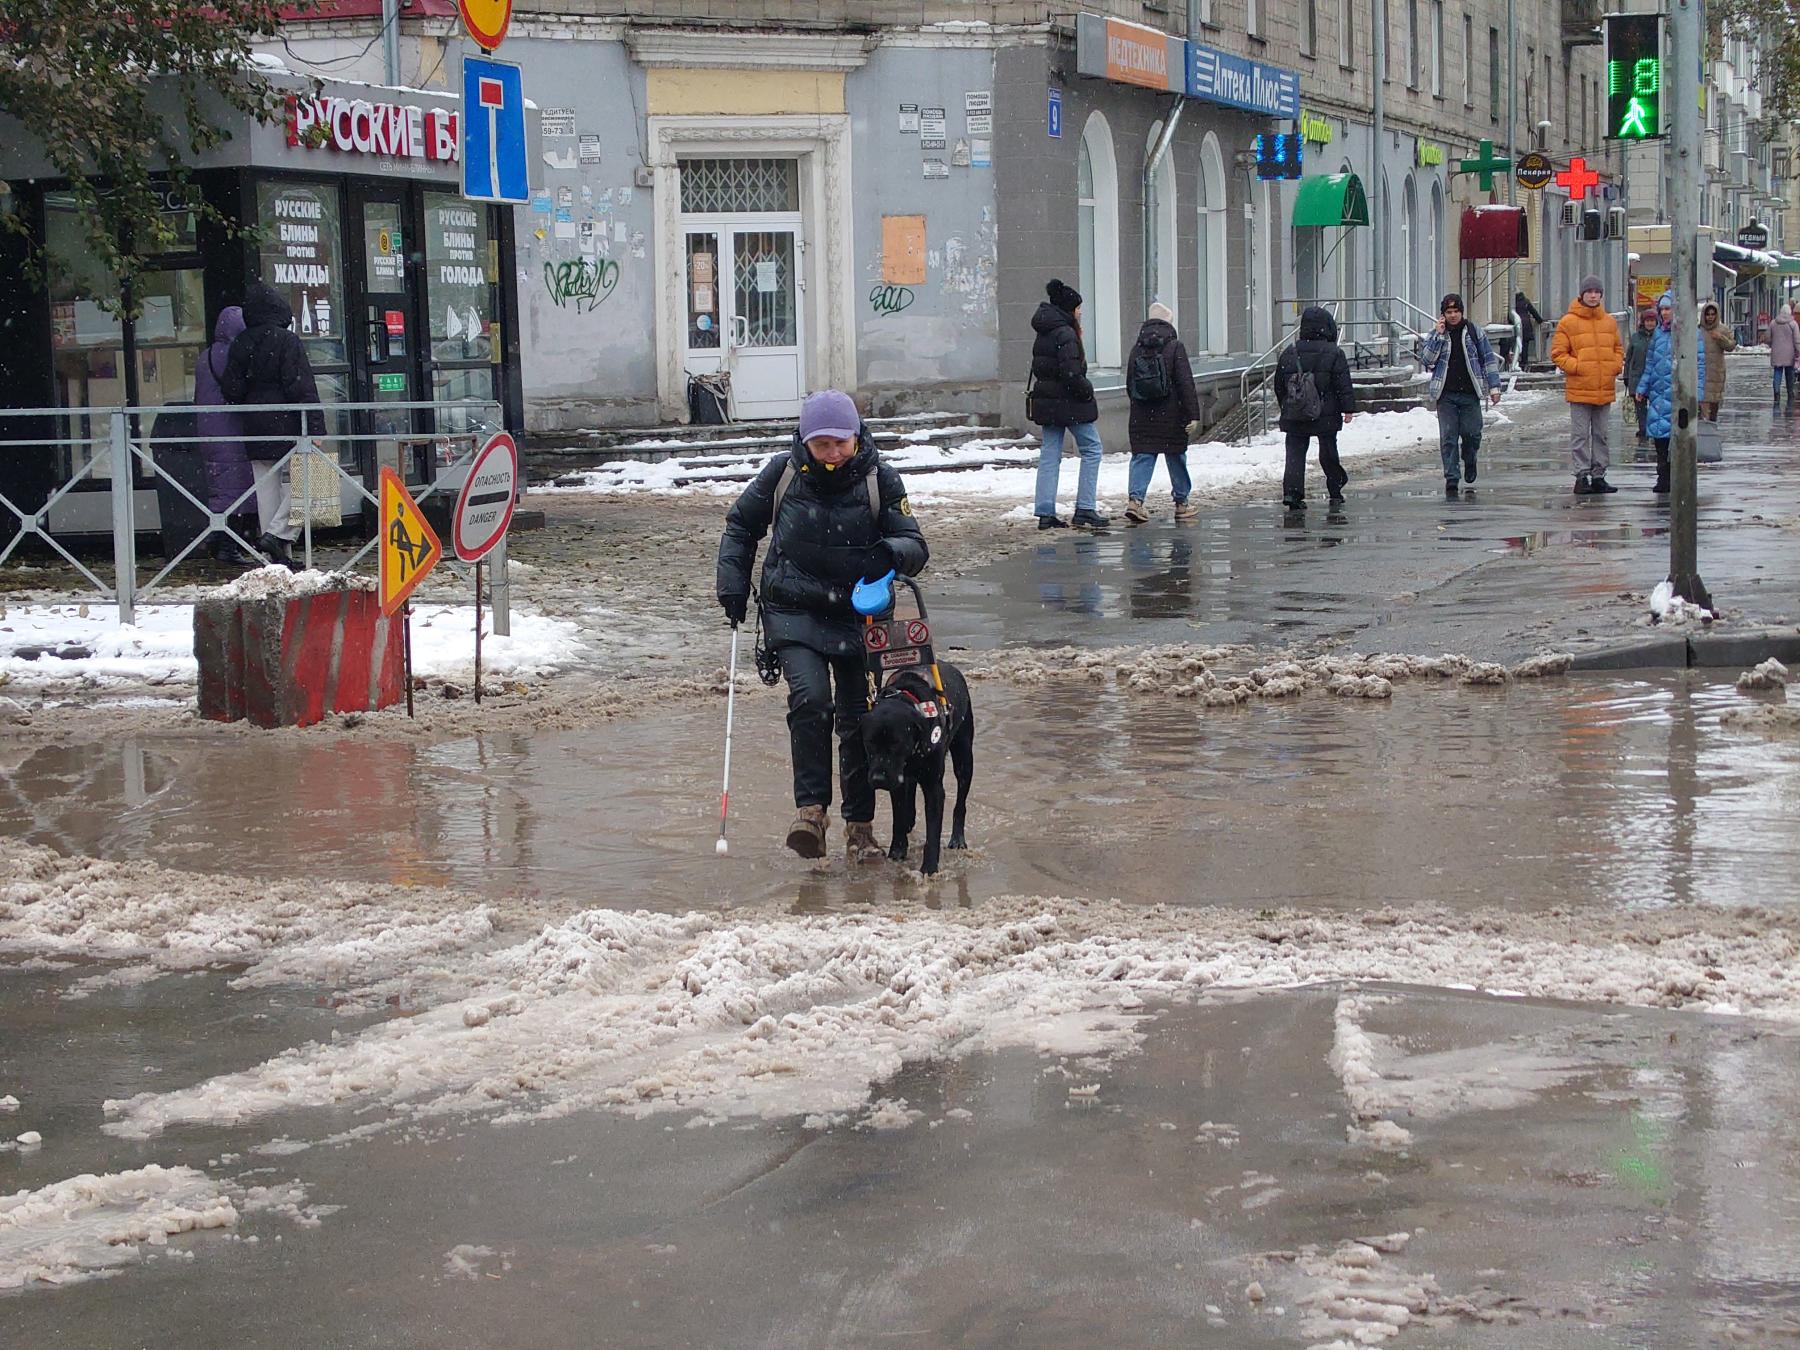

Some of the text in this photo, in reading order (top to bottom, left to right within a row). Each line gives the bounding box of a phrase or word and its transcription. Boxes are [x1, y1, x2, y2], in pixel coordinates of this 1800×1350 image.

[1108, 36, 1167, 76] МЕДТЕХНИКА
[1608, 59, 1659, 96] 18
[1053, 105, 1058, 131] 9
[275, 199, 321, 219] РУССКИЕ
[438, 209, 477, 227] РУССКИЕ
[280, 224, 318, 243] БЛИНЫ
[443, 231, 475, 248] БЛИНЫ
[286, 245, 316, 258] ПРОТИВ
[449, 249, 474, 260] ПРОТИВ
[273, 263, 330, 287] ЖАЖДЫ
[440, 265, 485, 287] ГОЛОДА
[474, 472, 511, 487] ОПАСНОСТЬ
[468, 511, 497, 526] DANGER
